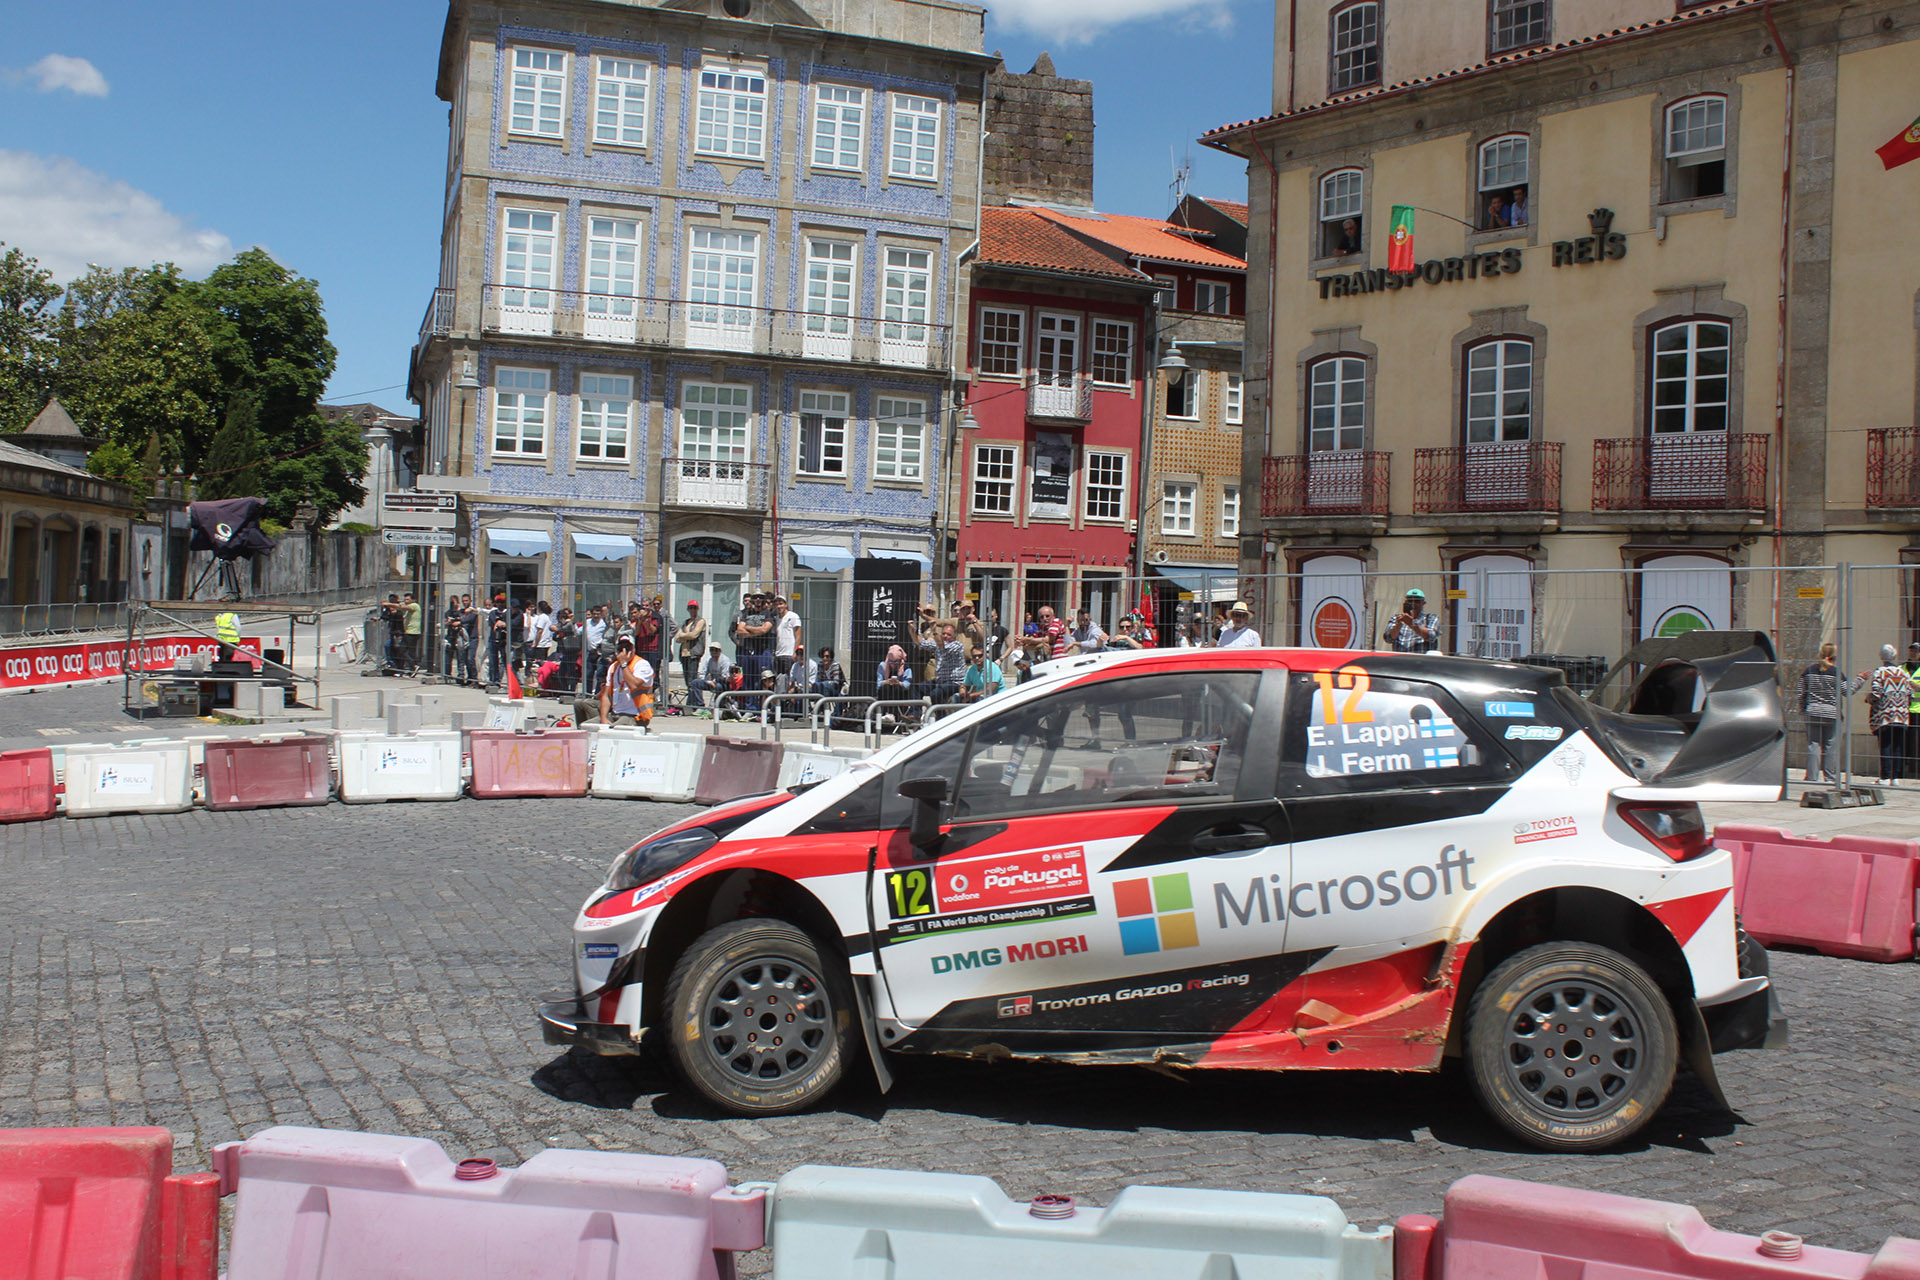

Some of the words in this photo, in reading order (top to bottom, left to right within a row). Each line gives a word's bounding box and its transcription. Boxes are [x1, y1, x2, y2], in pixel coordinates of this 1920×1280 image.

[1316, 247, 1522, 300] TRANSPORTES
[1551, 232, 1627, 268] REIS
[867, 619, 897, 629] BRAGA
[6, 657, 31, 680] acp
[35, 655, 59, 677] acp
[62, 653, 84, 675] acp
[88, 651, 104, 672] acp
[105, 650, 121, 670] acp
[1312, 664, 1375, 726] 12
[1306, 725, 1335, 747] E.
[1341, 719, 1418, 748] Lappi
[1311, 754, 1331, 777] J.
[1341, 752, 1412, 774] Ferm
[1530, 815, 1576, 830] TOYOTA
[984, 865, 1006, 875] rally
[1007, 864, 1020, 872] de
[984, 863, 1082, 890] Portugal
[889, 870, 931, 917] 12
[942, 892, 980, 903] vodafone
[1213, 843, 1477, 930] Microsoft
[927, 919, 943, 930] FIA
[942, 916, 967, 928] World
[967, 914, 988, 924] Rally
[989, 907, 1046, 922] Championship
[931, 948, 1003, 975] DMG
[1006, 935, 1089, 963] MORI
[999, 1002, 1030, 1017] GR
[1037, 992, 1111, 1012] TOYOTA
[1115, 982, 1183, 1001] GAZOO
[1187, 973, 1250, 991] Racing
